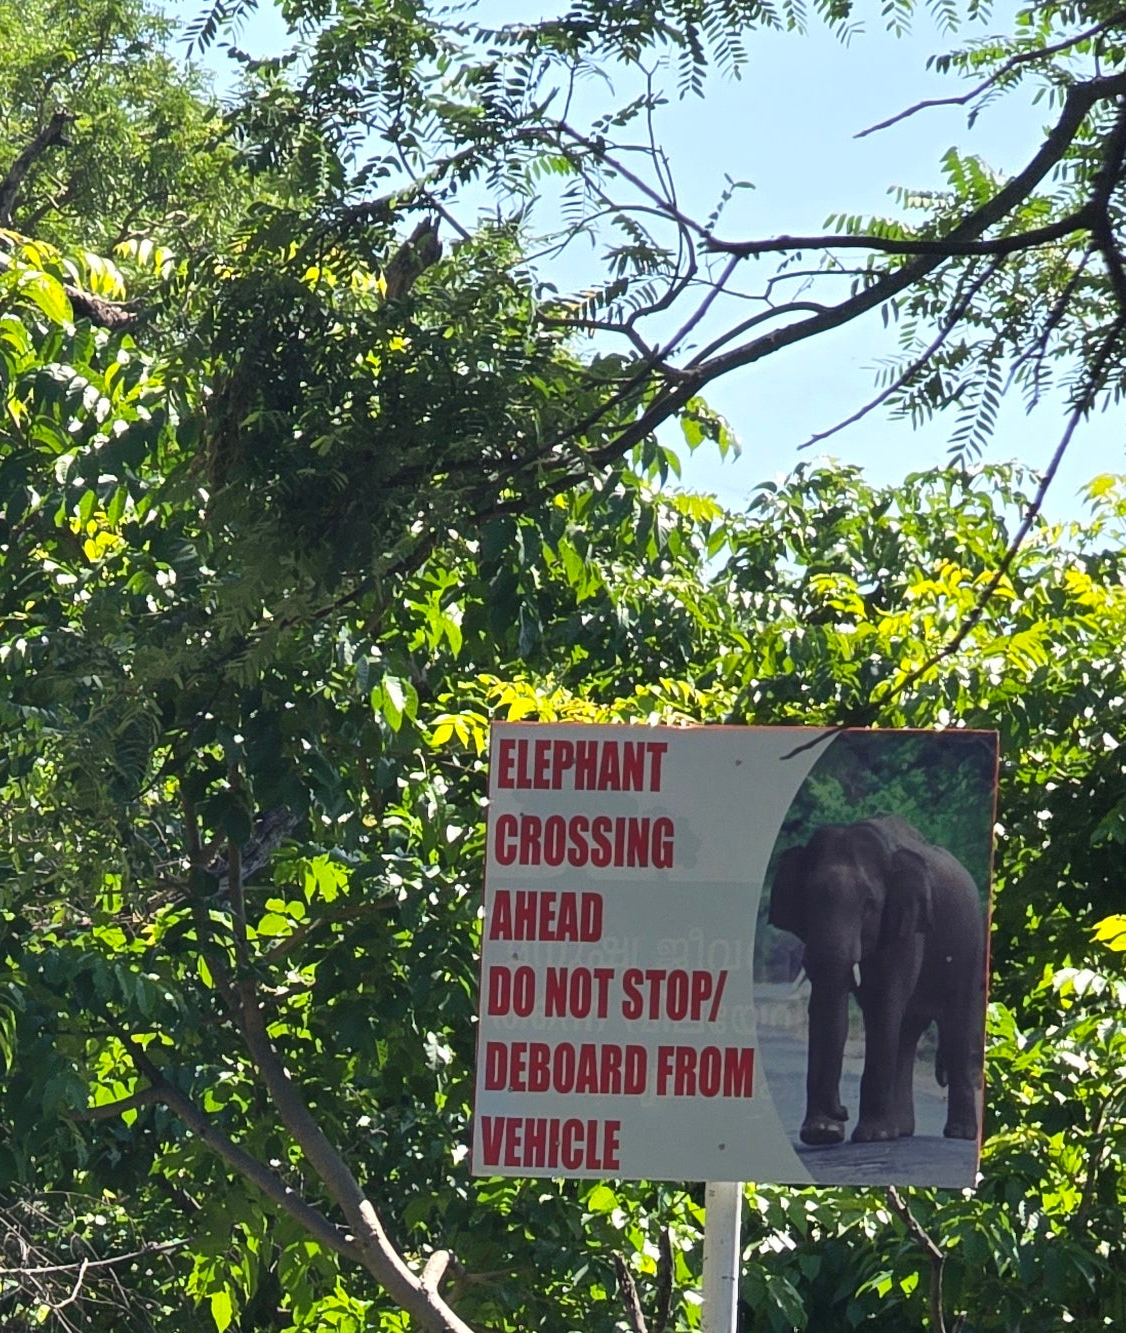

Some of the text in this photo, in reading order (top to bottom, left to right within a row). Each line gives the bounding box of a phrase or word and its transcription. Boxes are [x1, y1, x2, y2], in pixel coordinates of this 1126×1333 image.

[498, 738, 667, 791] ELEPHANT
[494, 813, 673, 867] CROSSING
[489, 890, 603, 942] AHEAD
[487, 965, 728, 1021] DO NOT STOP/
[485, 1042, 754, 1097] DEBOARD FROM
[481, 1116, 620, 1169] VEHICLE
